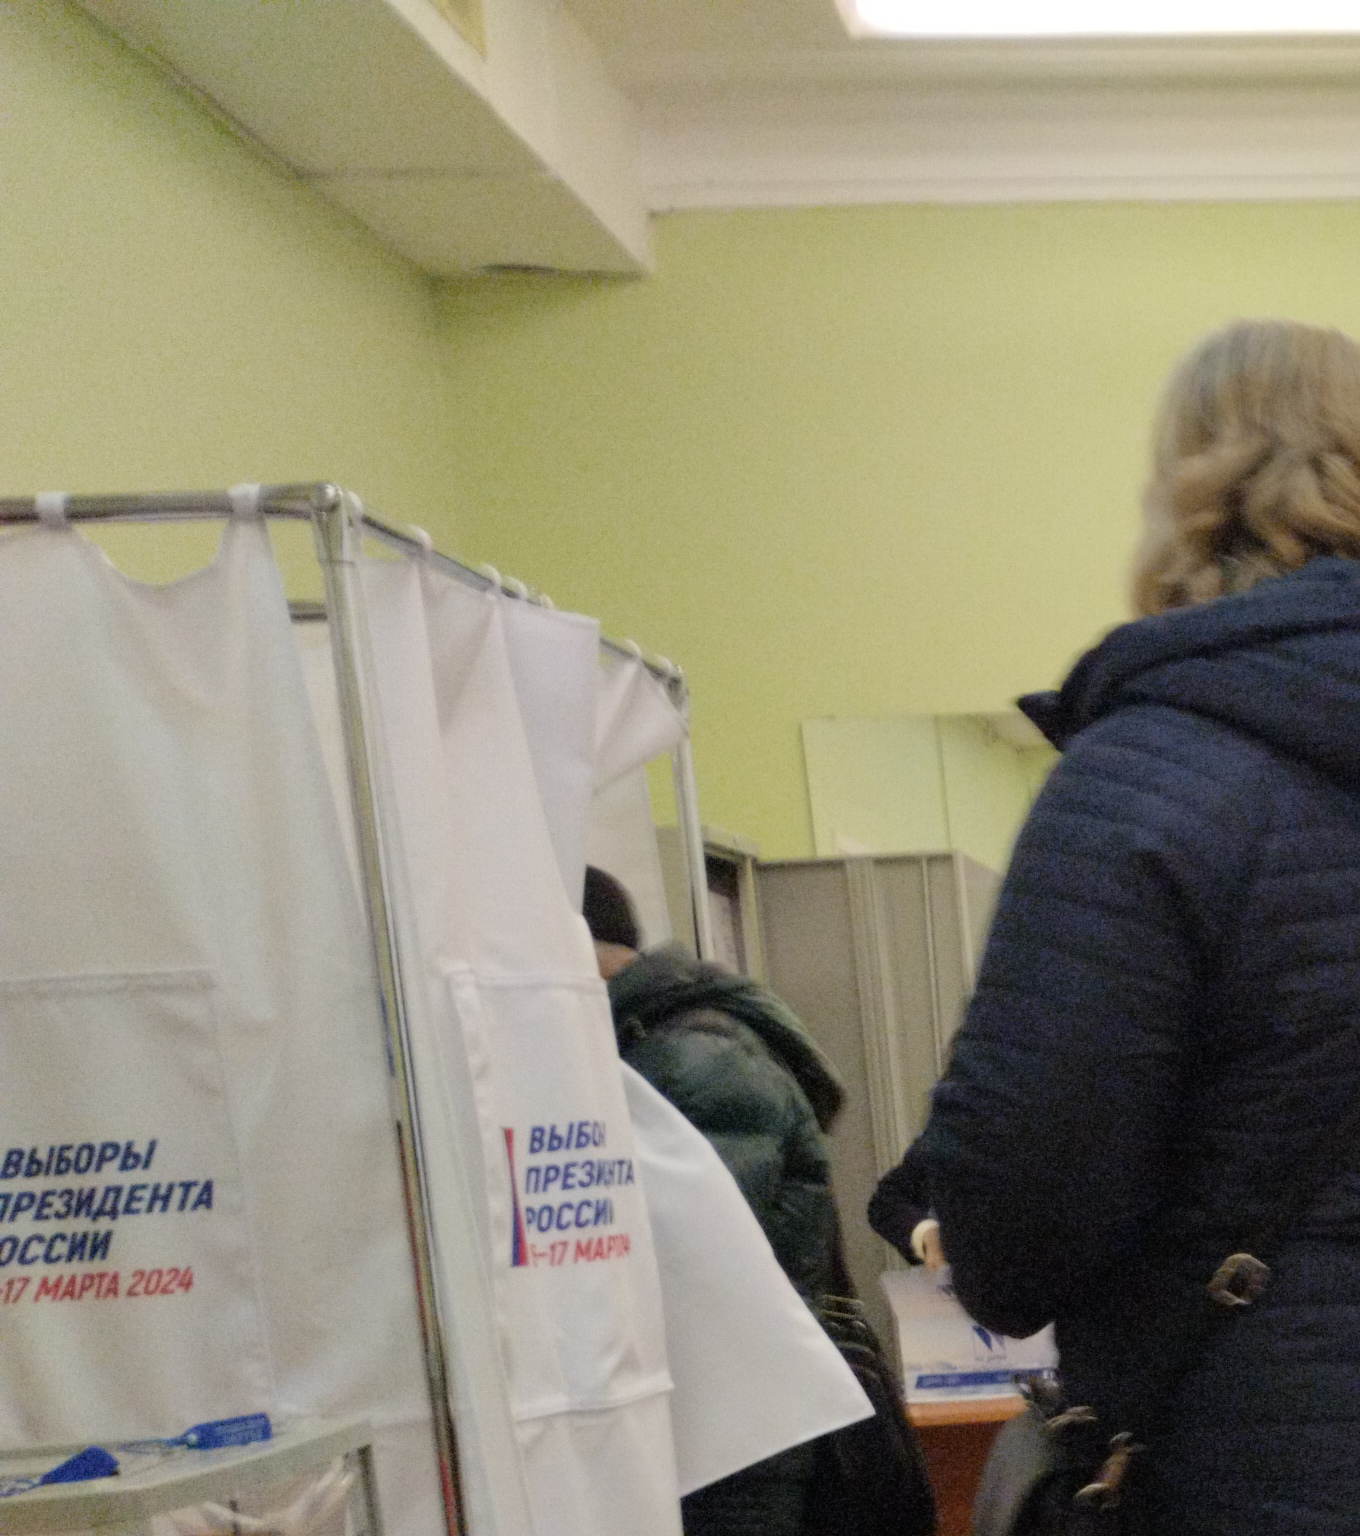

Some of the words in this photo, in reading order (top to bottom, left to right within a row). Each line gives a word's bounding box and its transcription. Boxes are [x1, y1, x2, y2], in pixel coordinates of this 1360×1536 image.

[529, 1120, 605, 1154] ВЫБО
[0, 1138, 158, 1179] ВЫБОРЫ
[0, 1230, 114, 1268] ОССИИ
[33, 1270, 120, 1303] МАРТА
[125, 1266, 194, 1297] 2024
